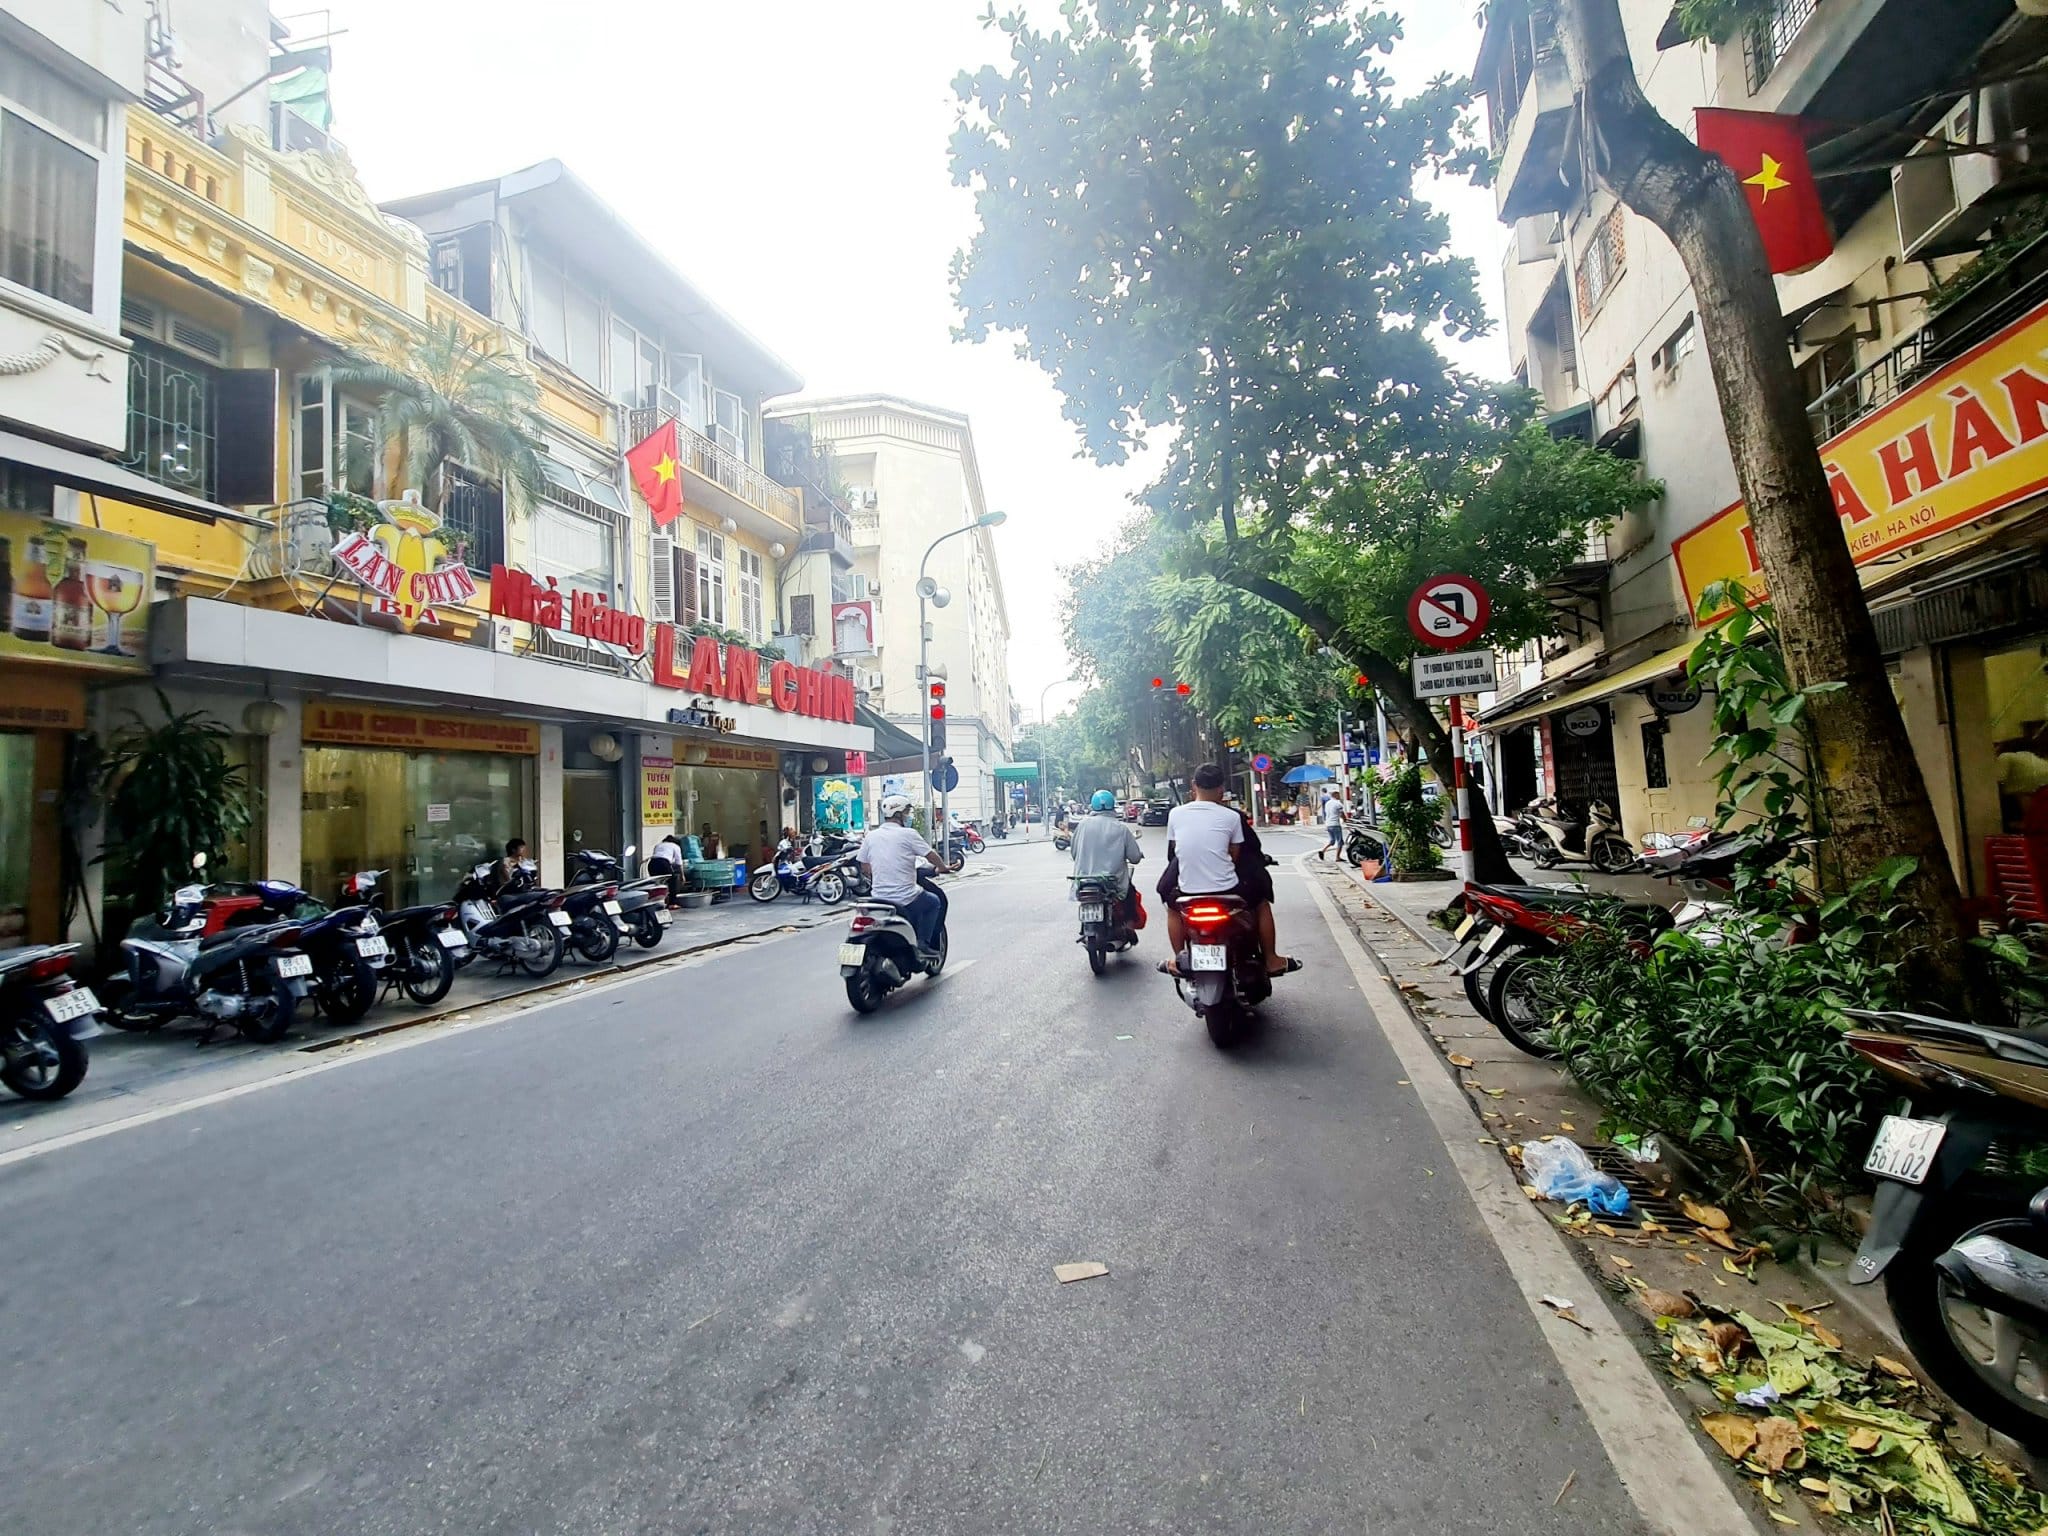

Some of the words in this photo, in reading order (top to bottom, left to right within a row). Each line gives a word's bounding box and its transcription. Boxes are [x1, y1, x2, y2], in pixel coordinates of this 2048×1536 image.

[303, 223, 368, 278] 1923
[1909, 505, 1936, 526] NỘI
[338, 535, 405, 597] LAN
[379, 598, 438, 625] BIA
[490, 563, 562, 630] Nhà
[571, 587, 645, 655] Hàng
[653, 622, 759, 704] LAN
[1570, 720, 1599, 730] BOLD
[59, 1001, 92, 1019] 7755
[1869, 1144, 1926, 1179] 561.02
